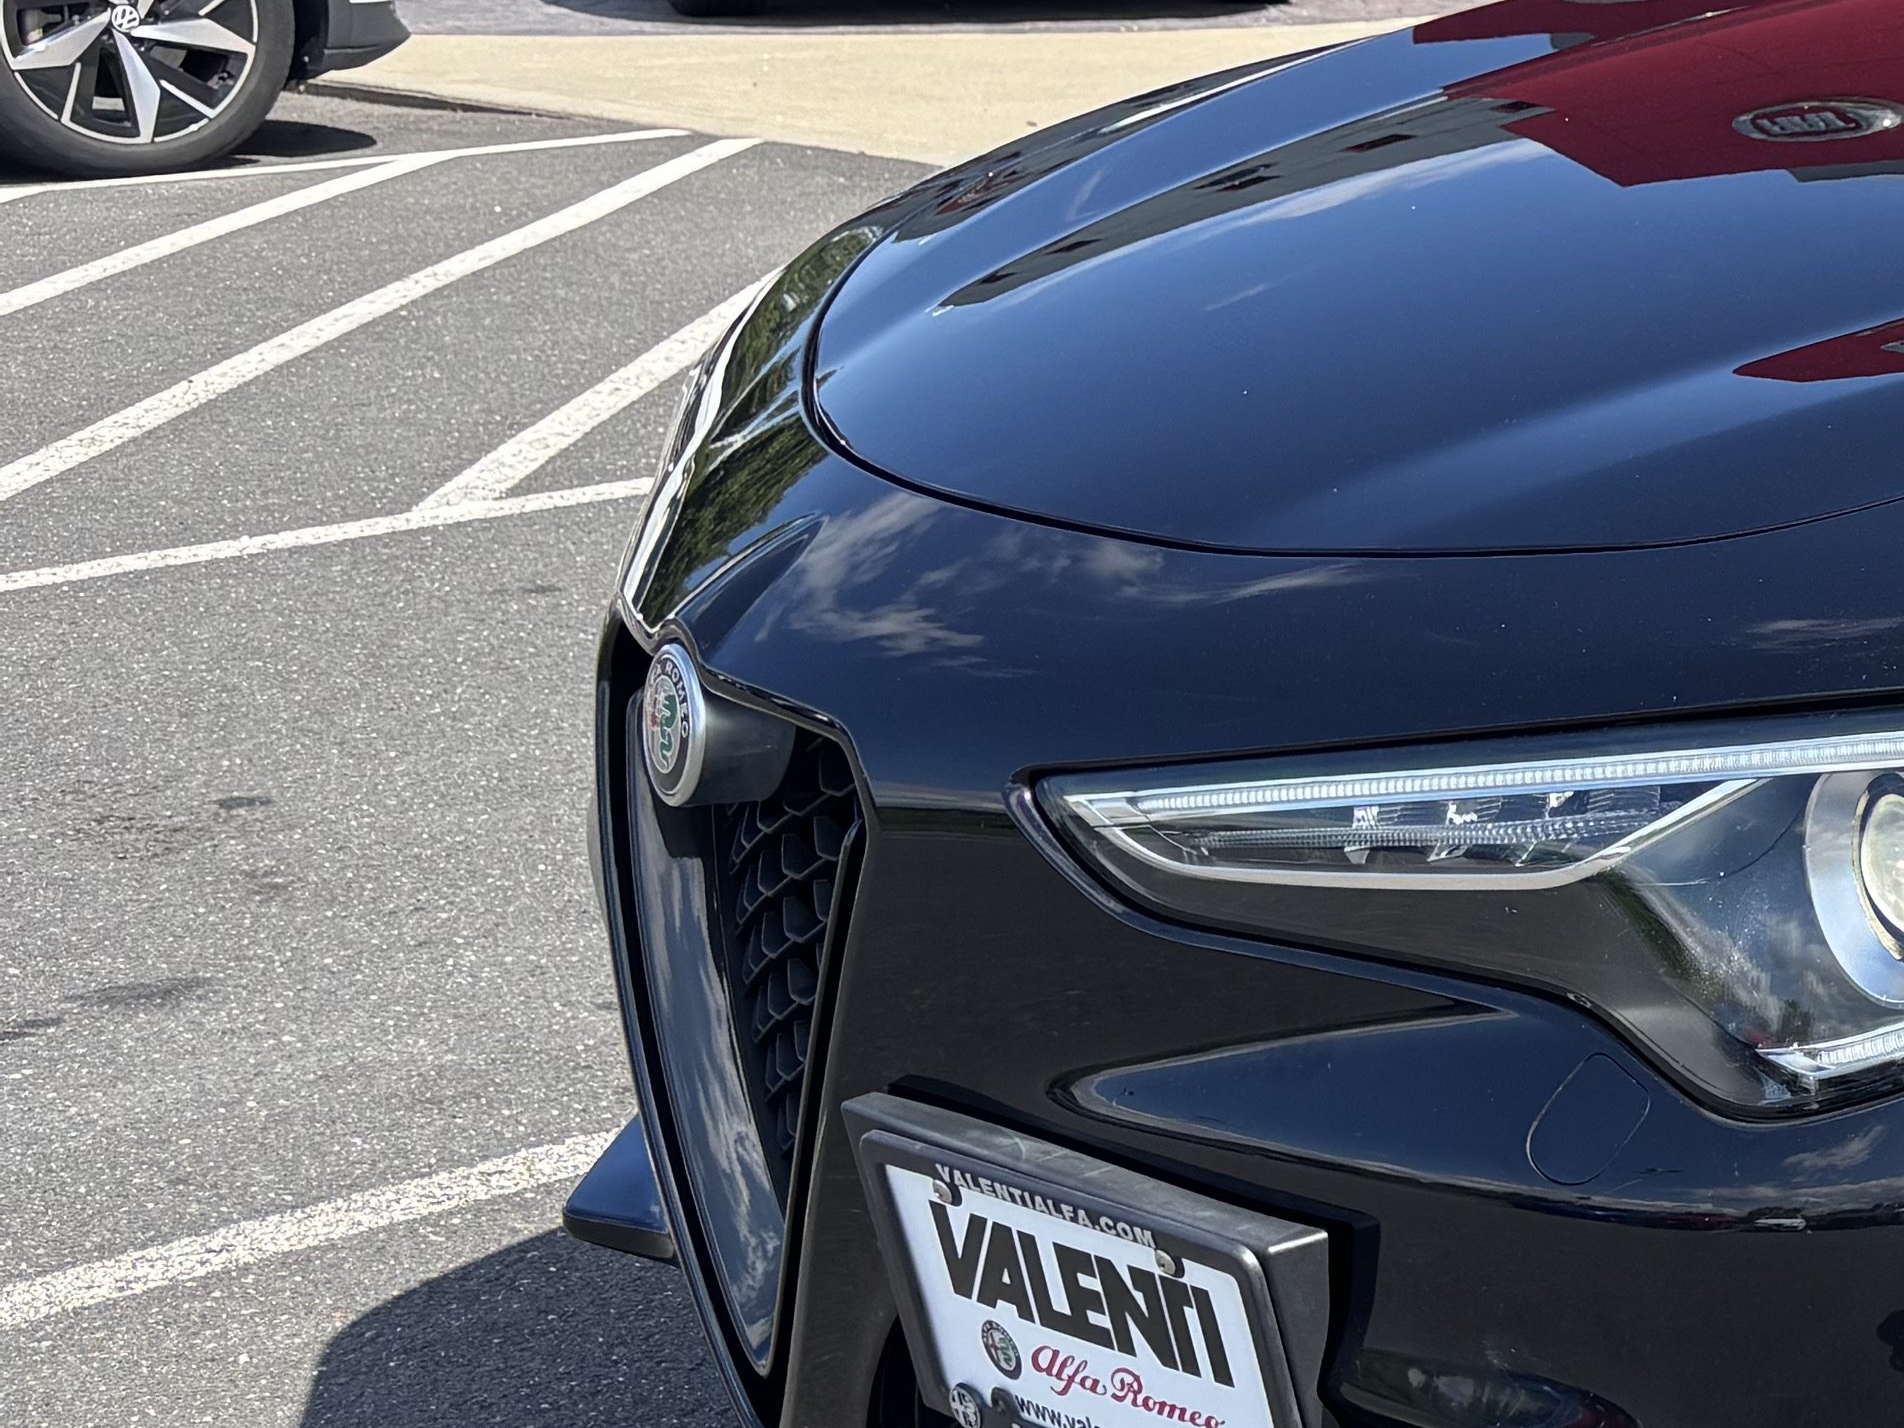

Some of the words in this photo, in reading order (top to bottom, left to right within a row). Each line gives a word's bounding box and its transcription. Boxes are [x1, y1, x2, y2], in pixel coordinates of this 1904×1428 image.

[935, 1162, 1157, 1250] VALENTIALFA.COM
[928, 1199, 1236, 1389] VALENTI
[1031, 1344, 1108, 1398] Alfa
